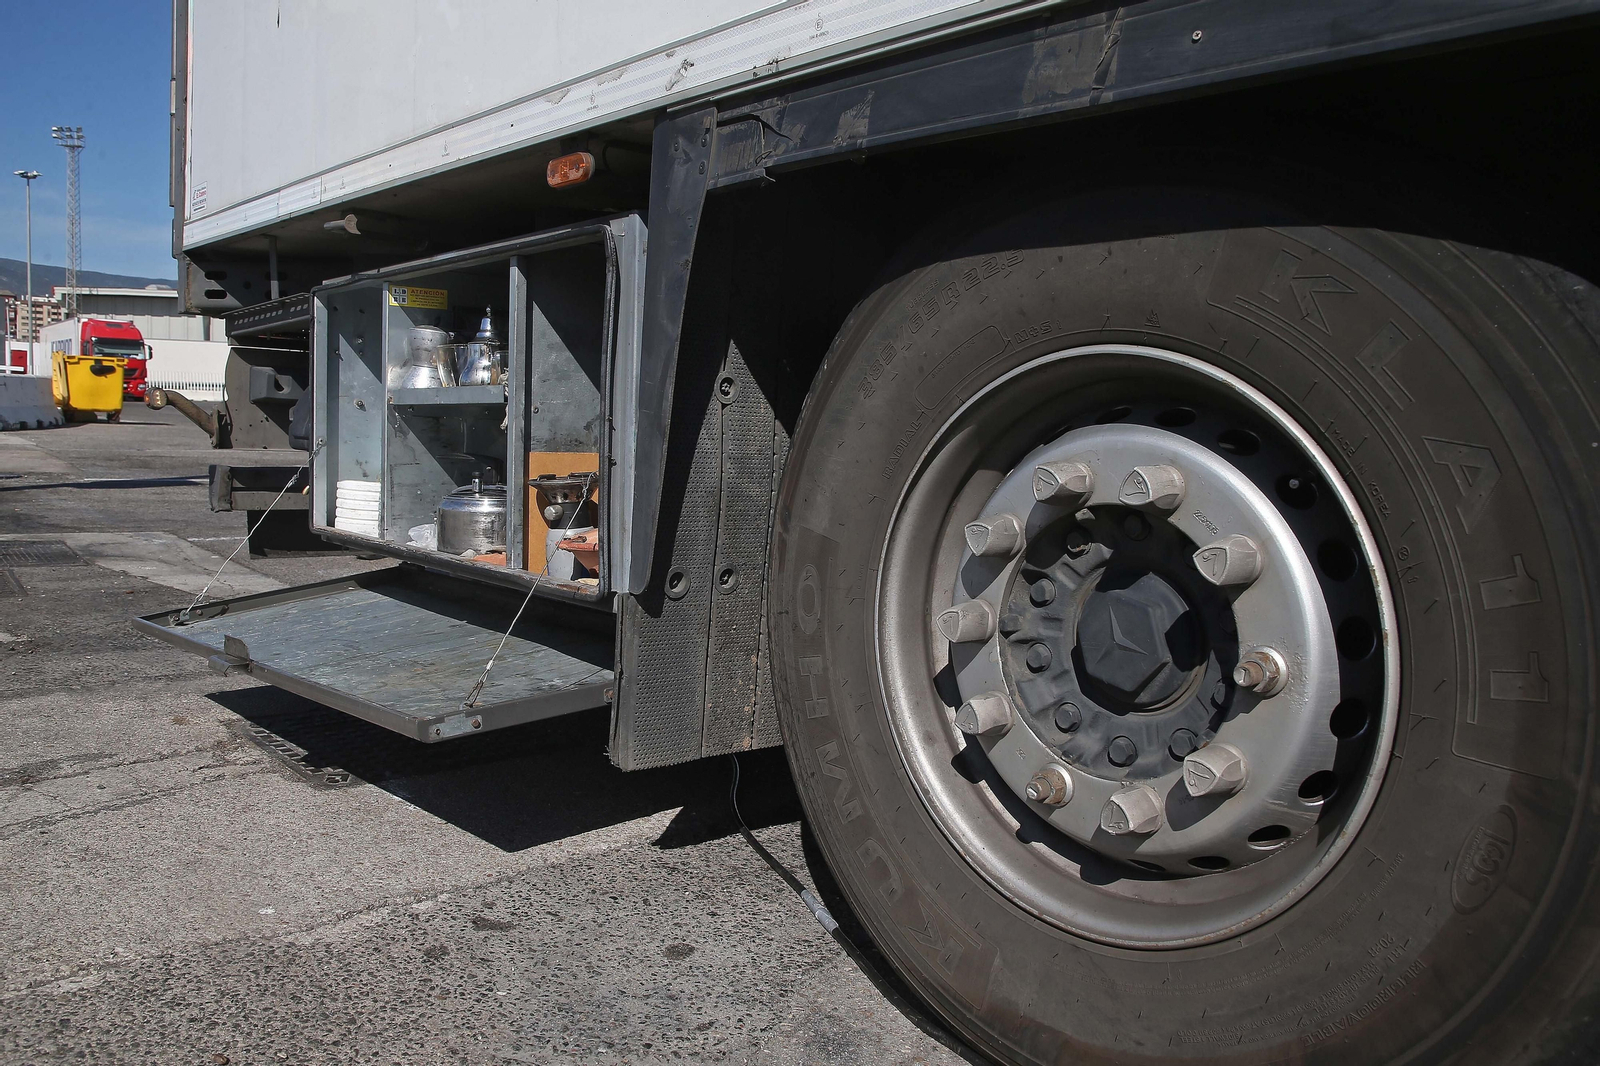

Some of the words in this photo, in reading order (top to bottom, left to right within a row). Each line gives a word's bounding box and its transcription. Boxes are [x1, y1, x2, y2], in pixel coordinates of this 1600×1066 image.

[882, 419, 922, 480] RADIAL
[1332, 428, 1356, 457] MADE
[1357, 462, 1369, 476] IN
[1369, 480, 1391, 520] KOREA
[795, 563, 965, 976] KUMHO
[1300, 958, 1426, 1047] REGROOVABLE
